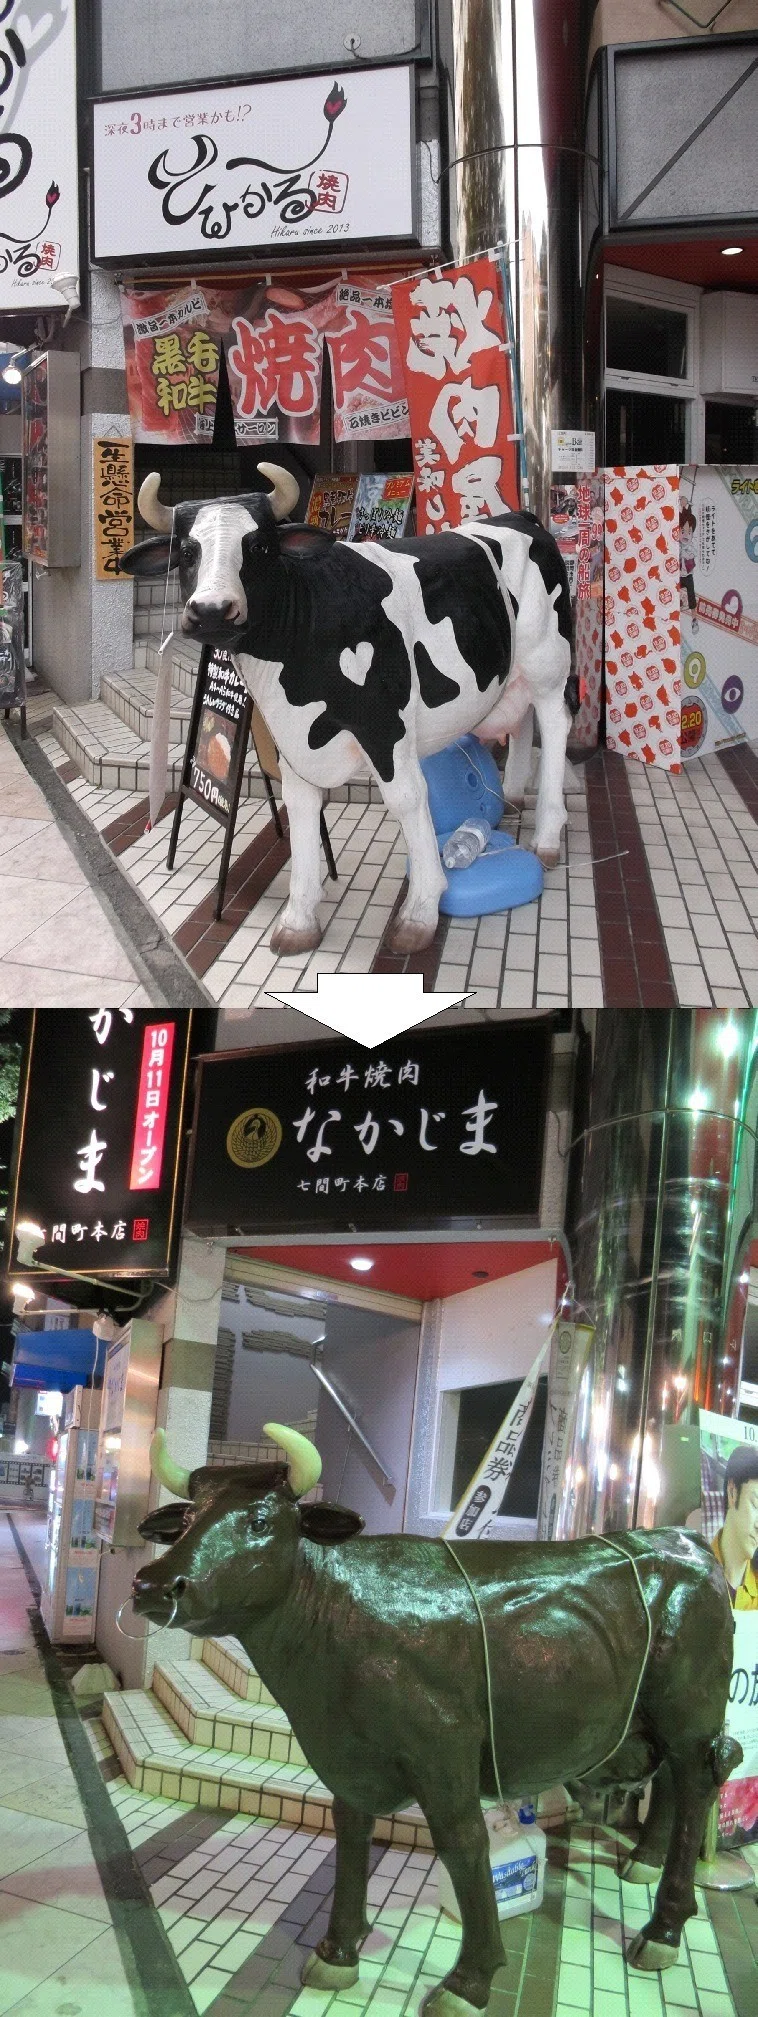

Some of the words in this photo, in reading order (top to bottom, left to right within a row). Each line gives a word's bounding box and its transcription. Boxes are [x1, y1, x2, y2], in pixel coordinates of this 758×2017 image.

[270, 225, 299, 239] Hikaru
[303, 225, 323, 236] since
[326, 222, 350, 234] 2013
[577, 484, 591, 601] 地球一周の船旅
[304, 1059, 420, 1095] 和牛焼肉
[138, 1029, 169, 1185] 10月11日オープン
[292, 1089, 498, 1163] なかじま
[296, 1173, 388, 1194] 七間町本店
[42, 1220, 127, 1244] 間町本店
